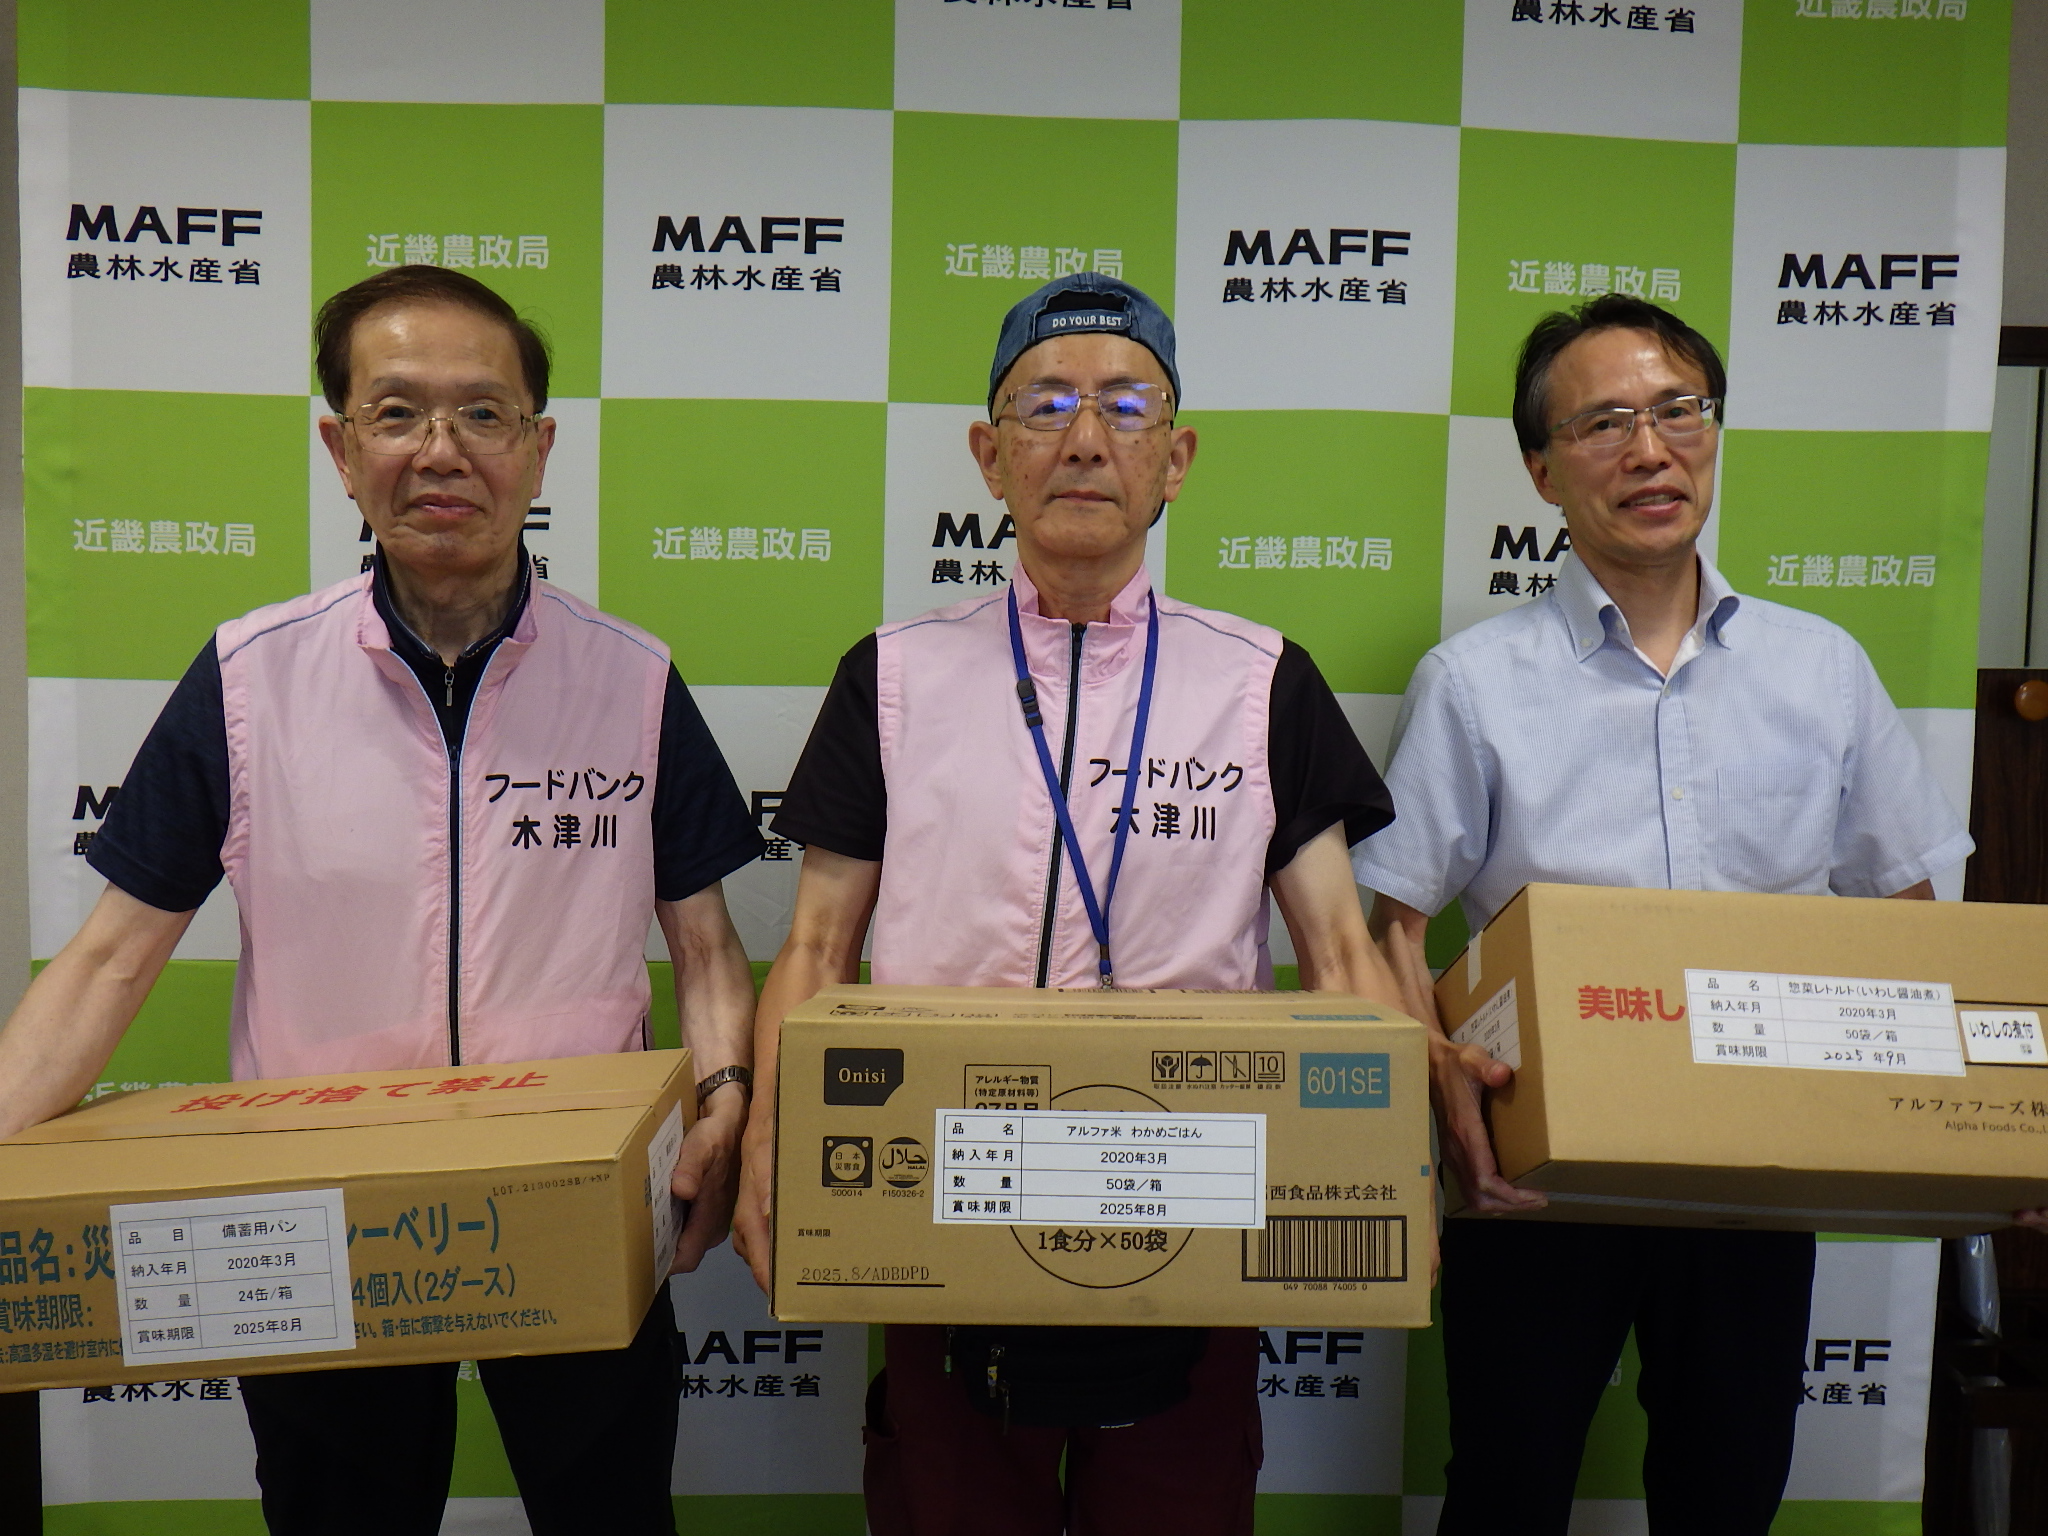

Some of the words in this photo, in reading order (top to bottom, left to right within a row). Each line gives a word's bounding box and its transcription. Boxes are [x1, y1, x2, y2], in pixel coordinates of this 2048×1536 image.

[66, 204, 263, 247] MAFF
[652, 215, 845, 254] MAFF
[366, 234, 550, 270] 近畿農政局
[1223, 228, 1411, 267] MAFF
[67, 253, 261, 285] 農林水産省
[944, 243, 1124, 281] 近畿農政局
[1778, 253, 1959, 290] MAFF
[652, 264, 842, 293] 農林水産省
[1222, 276, 1408, 305] 農林水産省
[1508, 259, 1682, 301] 近畿農政局
[1052, 318, 1067, 328] DO
[1069, 315, 1097, 326] YOUR
[1099, 315, 1123, 326] BEST
[1776, 300, 1957, 326] 農林水産省
[73, 519, 256, 557] 近畿農政局
[931, 512, 1017, 549] MA
[1490, 525, 1573, 562] MA
[652, 526, 831, 562] 近畿農政局
[1218, 535, 1392, 571] 近畿農政局
[1767, 554, 1936, 588] 近畿農政局
[485, 767, 645, 803] フードバンク
[1089, 756, 1244, 792] フードバンク
[511, 814, 617, 849] 木津川
[1578, 984, 1686, 1022] 美味し
[1710, 1000, 1762, 1015] 納入年月
[1838, 1006, 1897, 1021] 2020年3月
[1969, 1020, 2034, 1040] いわしの煮付
[1258, 1055, 1279, 1073] 10
[1715, 1043, 1769, 1059] 賞味期限
[1823, 1049, 1864, 1062] 2025
[838, 1067, 887, 1084] Onisi
[975, 1075, 1039, 1086] アレルギー物質
[1307, 1066, 1383, 1095] 601SE
[170, 1072, 549, 1114] 投げ捨て禁止
[1066, 1125, 1122, 1138] アルファ米
[1130, 1126, 1203, 1139] わかめごはん
[1945, 1121, 1978, 1132] Alpha
[1982, 1122, 2017, 1133] Foods
[882, 1147, 927, 1170] حلال
[951, 1148, 1014, 1162] 納入年月
[1100, 1151, 1168, 1165] 2020年3月
[1265, 1184, 1398, 1201] 西食品株式会社
[952, 1200, 1012, 1214] 賞味期限
[1099, 1203, 1168, 1216] 2025年8月
[222, 1221, 298, 1239] 備蓄用パン
[131, 1261, 188, 1278] 納入年月
[227, 1252, 297, 1270] 2020年3月
[238, 1286, 293, 1302] 24缶/箱
[1283, 1283, 1298, 1291] 049
[1303, 1283, 1328, 1291] 70088
[1333, 1283, 1357, 1291] 74005
[1362, 1283, 1368, 1291] 0
[138, 1327, 195, 1344] 賞味期限
[234, 1317, 302, 1335] 2025年8月
[677, 1329, 824, 1365] AFF
[682, 1373, 821, 1399] 林水産省
